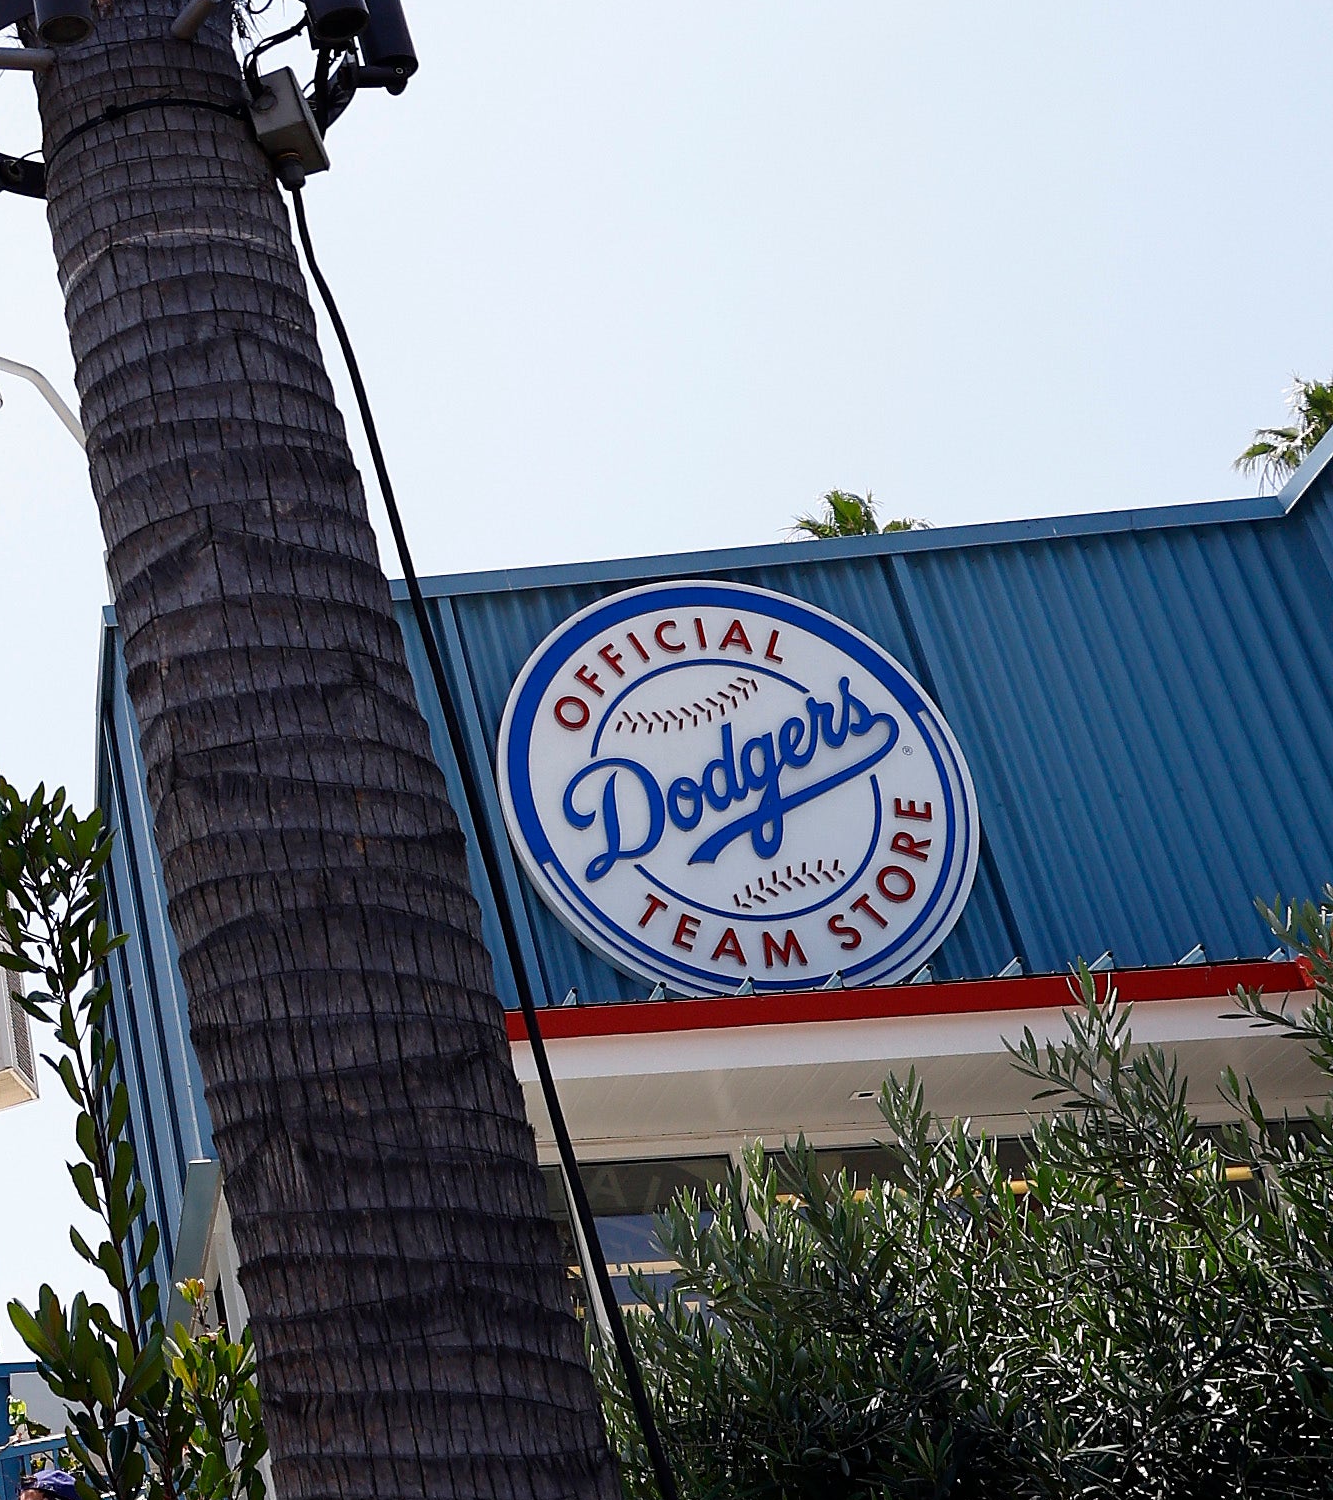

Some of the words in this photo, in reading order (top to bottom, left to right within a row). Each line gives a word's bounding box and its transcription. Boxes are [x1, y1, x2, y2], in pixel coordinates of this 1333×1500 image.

[554, 616, 784, 731] OFFICIAL
[562, 676, 900, 882] Dodgers
[637, 893, 809, 970] TEAM
[827, 796, 933, 951] STORE
